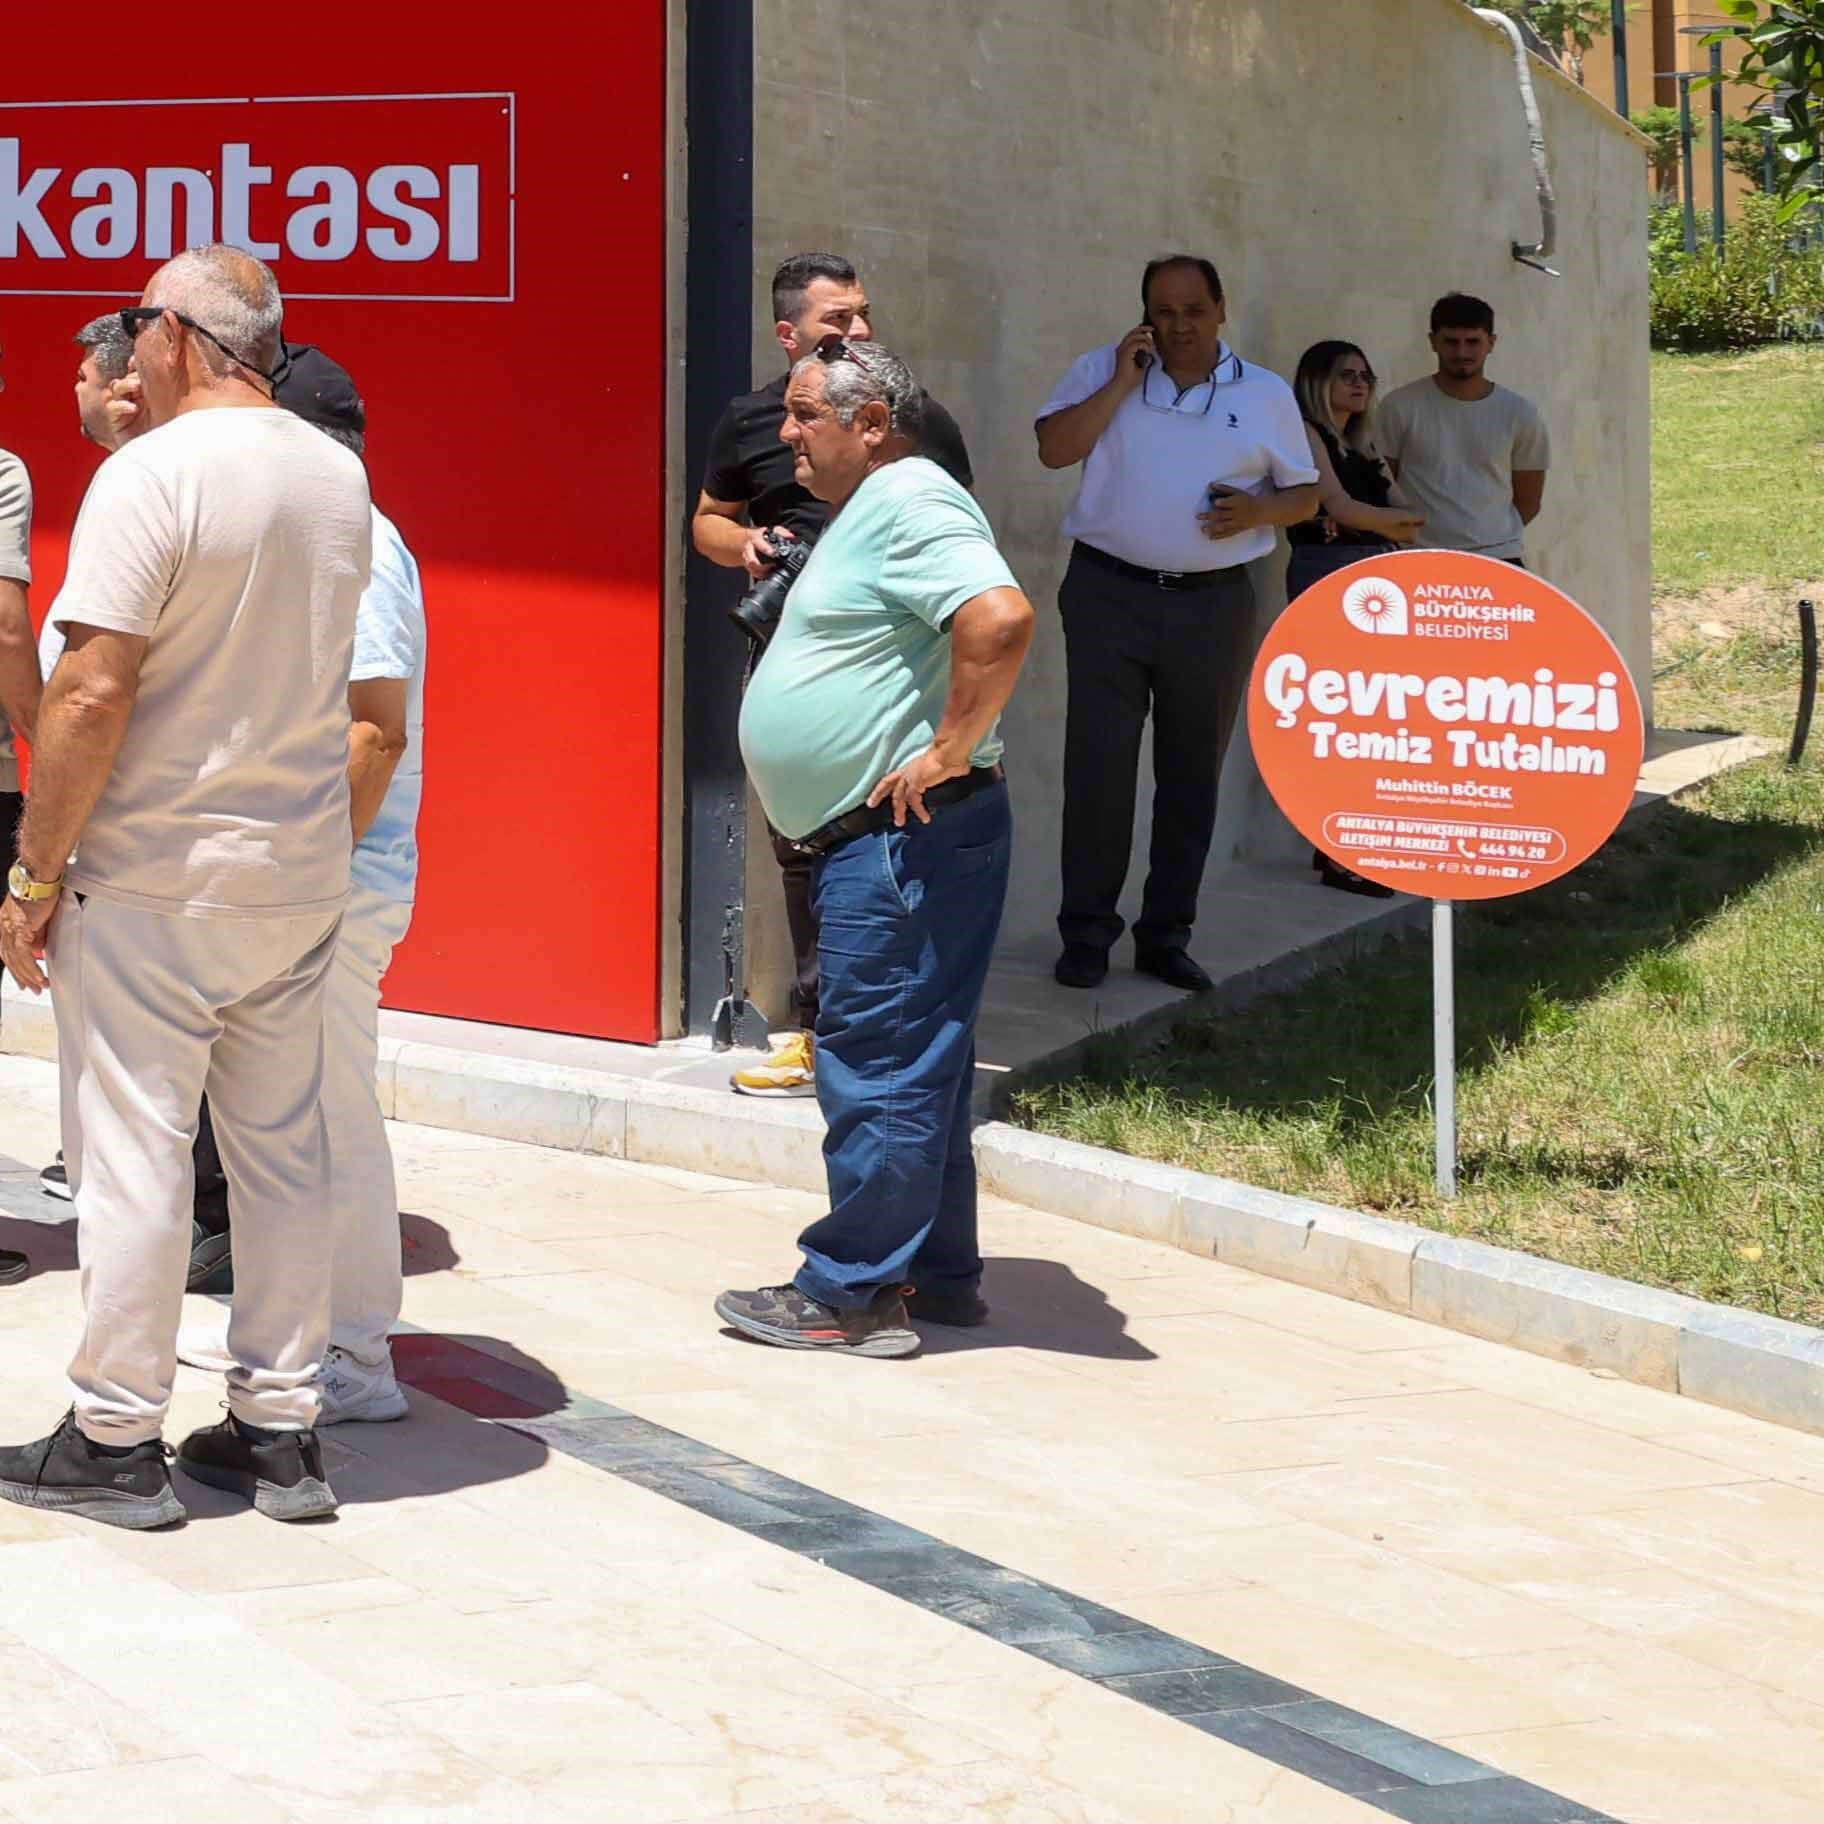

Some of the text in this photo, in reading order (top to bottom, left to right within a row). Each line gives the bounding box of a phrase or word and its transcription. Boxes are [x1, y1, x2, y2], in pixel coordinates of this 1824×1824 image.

[1414, 584, 1494, 601] ANTALYA
[1414, 600, 1536, 623] BÜYÜKŞEHİR
[1415, 622, 1509, 641] BELEDİYESİ
[1264, 653, 1620, 731] Çevremizi
[1308, 721, 1606, 775] Temiz Tutalım
[1376, 777, 1513, 799] Muhittin BÖCEK
[1336, 816, 1394, 833] ANTALYA
[1479, 843, 1505, 857] 444
[1527, 847, 1546, 860] 20
